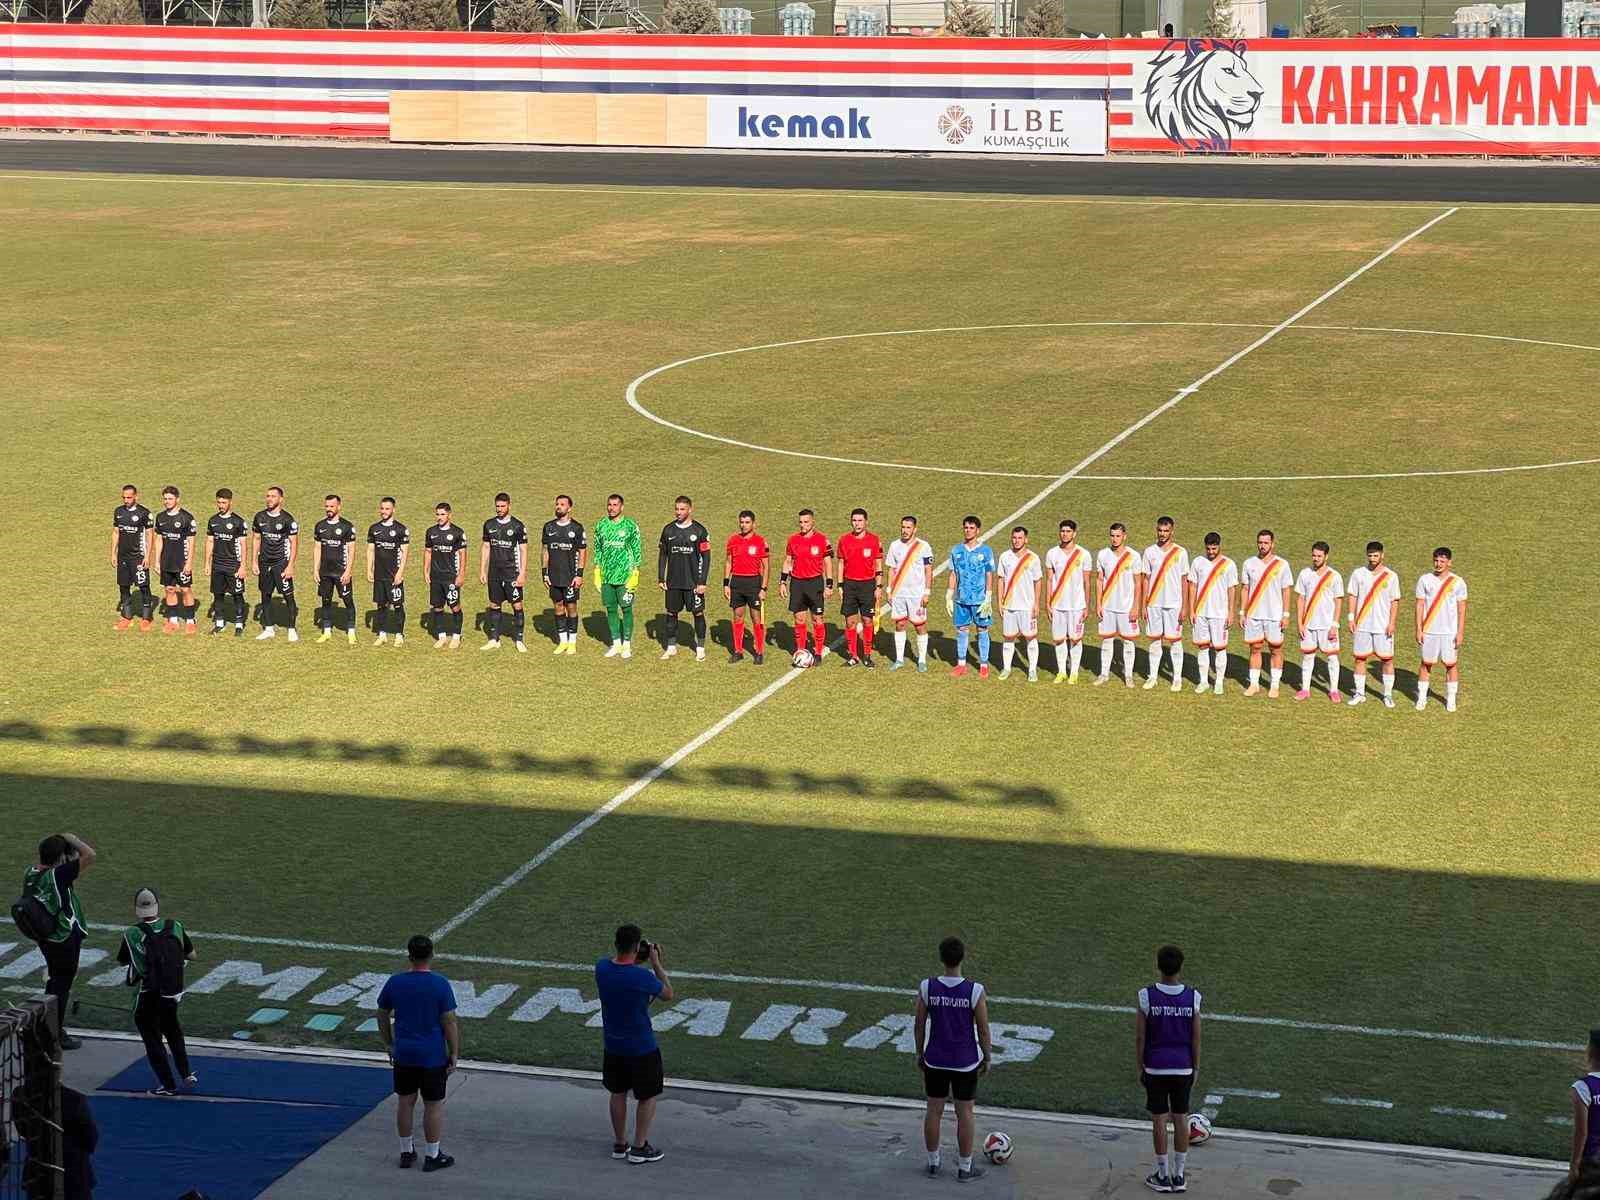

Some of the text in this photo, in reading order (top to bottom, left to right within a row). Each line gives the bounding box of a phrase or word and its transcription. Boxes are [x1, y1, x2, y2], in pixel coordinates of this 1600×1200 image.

[738, 106, 872, 139] kemak
[990, 103, 1064, 132] İLBE
[983, 135, 1070, 150] KUMAŞÇILIK
[392, 587, 402, 598] 10
[447, 590, 458, 600] 49
[929, 996, 940, 1006] TOP
[1151, 1006, 1162, 1016] TOP
